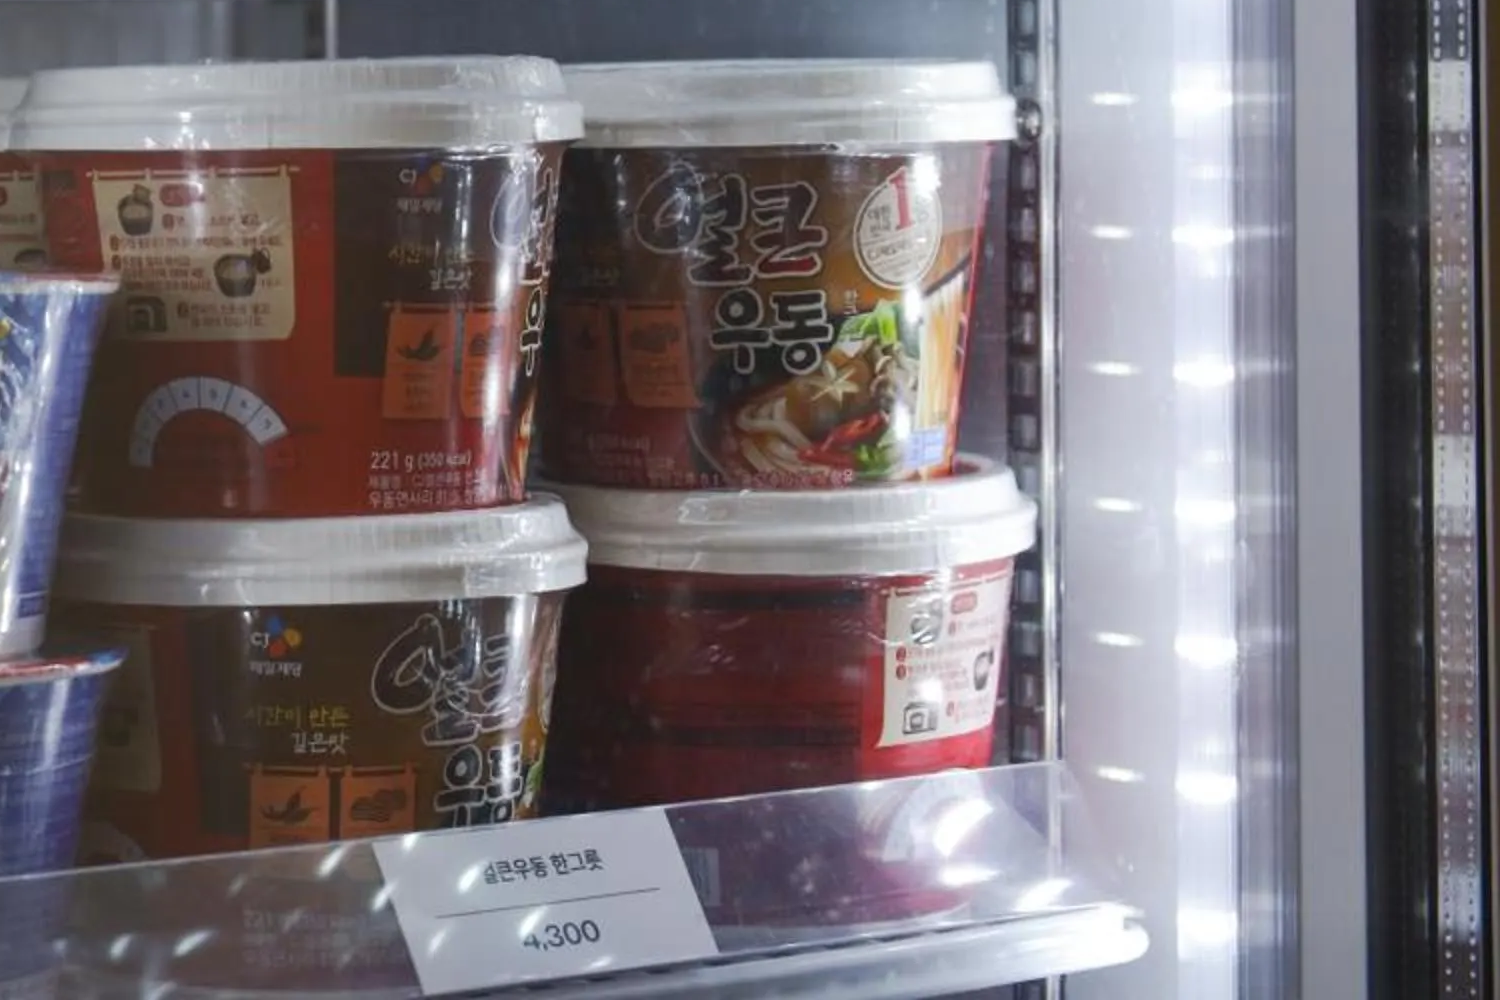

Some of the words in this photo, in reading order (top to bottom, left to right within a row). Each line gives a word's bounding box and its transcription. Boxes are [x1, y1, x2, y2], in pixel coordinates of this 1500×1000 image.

[711, 288, 833, 375] 우동
[370, 450, 399, 470] 221
[404, 454, 414, 473] g
[250, 632, 271, 649] CJ
[550, 848, 606, 877] 한그릇
[523, 918, 601, 952] 4,300
